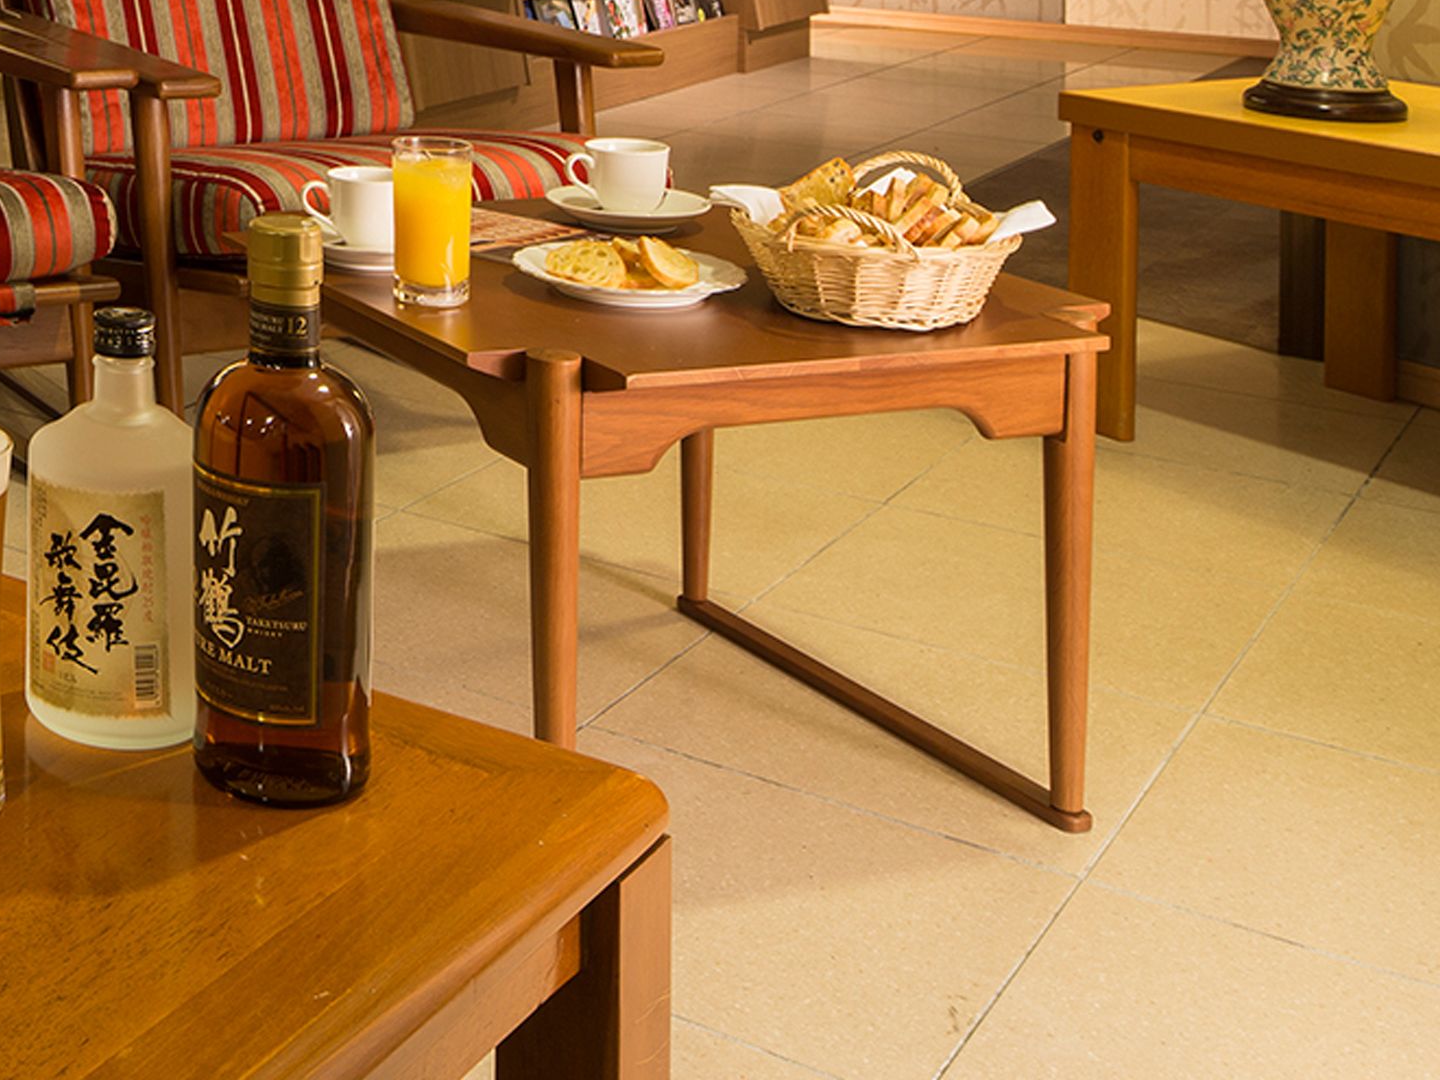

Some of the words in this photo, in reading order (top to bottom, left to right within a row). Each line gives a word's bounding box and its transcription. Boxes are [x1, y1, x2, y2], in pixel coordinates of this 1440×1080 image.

[288, 316, 307, 335] 12
[199, 506, 245, 648] 竹鶴
[219, 648, 273, 675] MALT
